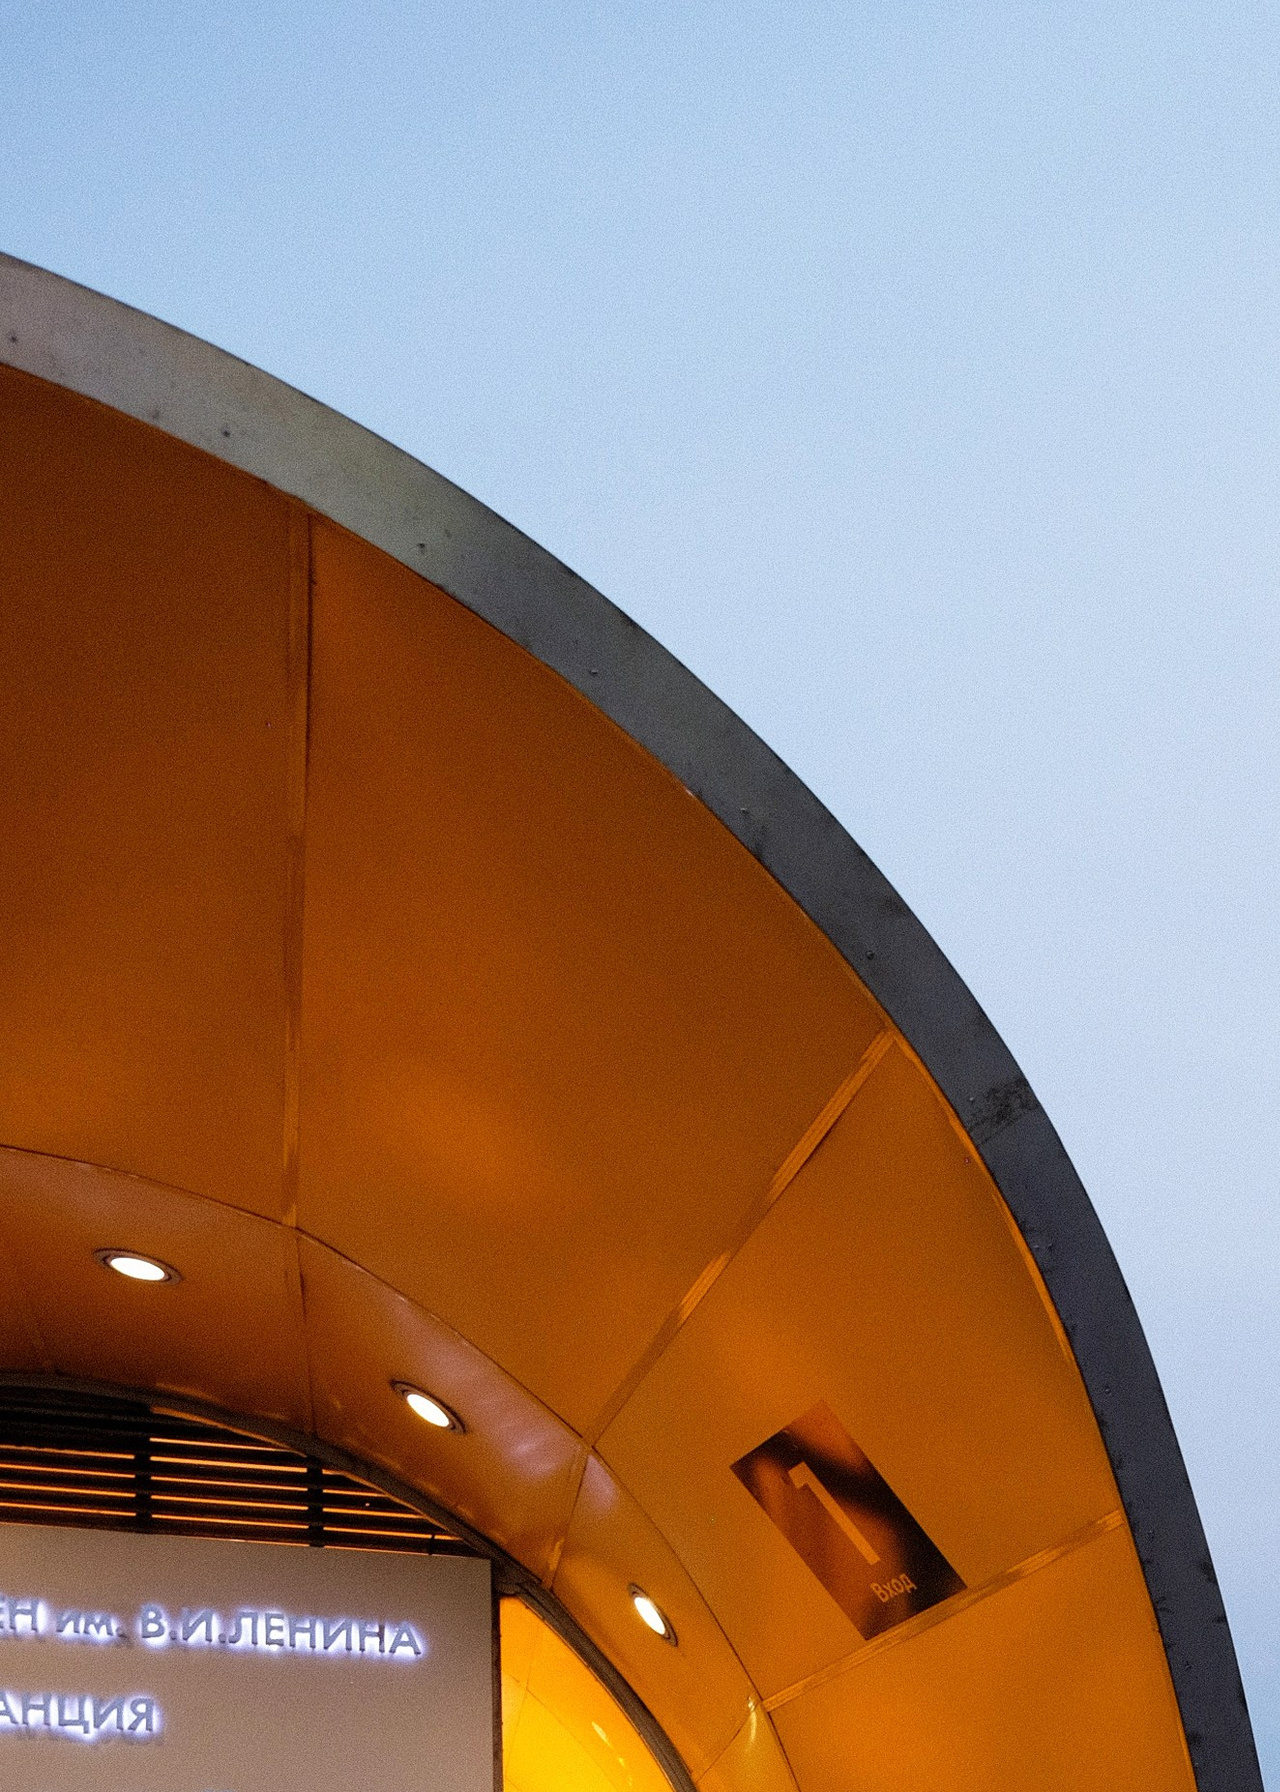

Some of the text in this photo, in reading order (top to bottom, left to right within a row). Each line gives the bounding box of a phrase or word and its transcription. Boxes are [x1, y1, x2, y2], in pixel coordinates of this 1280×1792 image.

[870, 1573, 917, 1603] Вход
[0, 1597, 422, 1656] Н им. В.И.ЛЕНИНА
